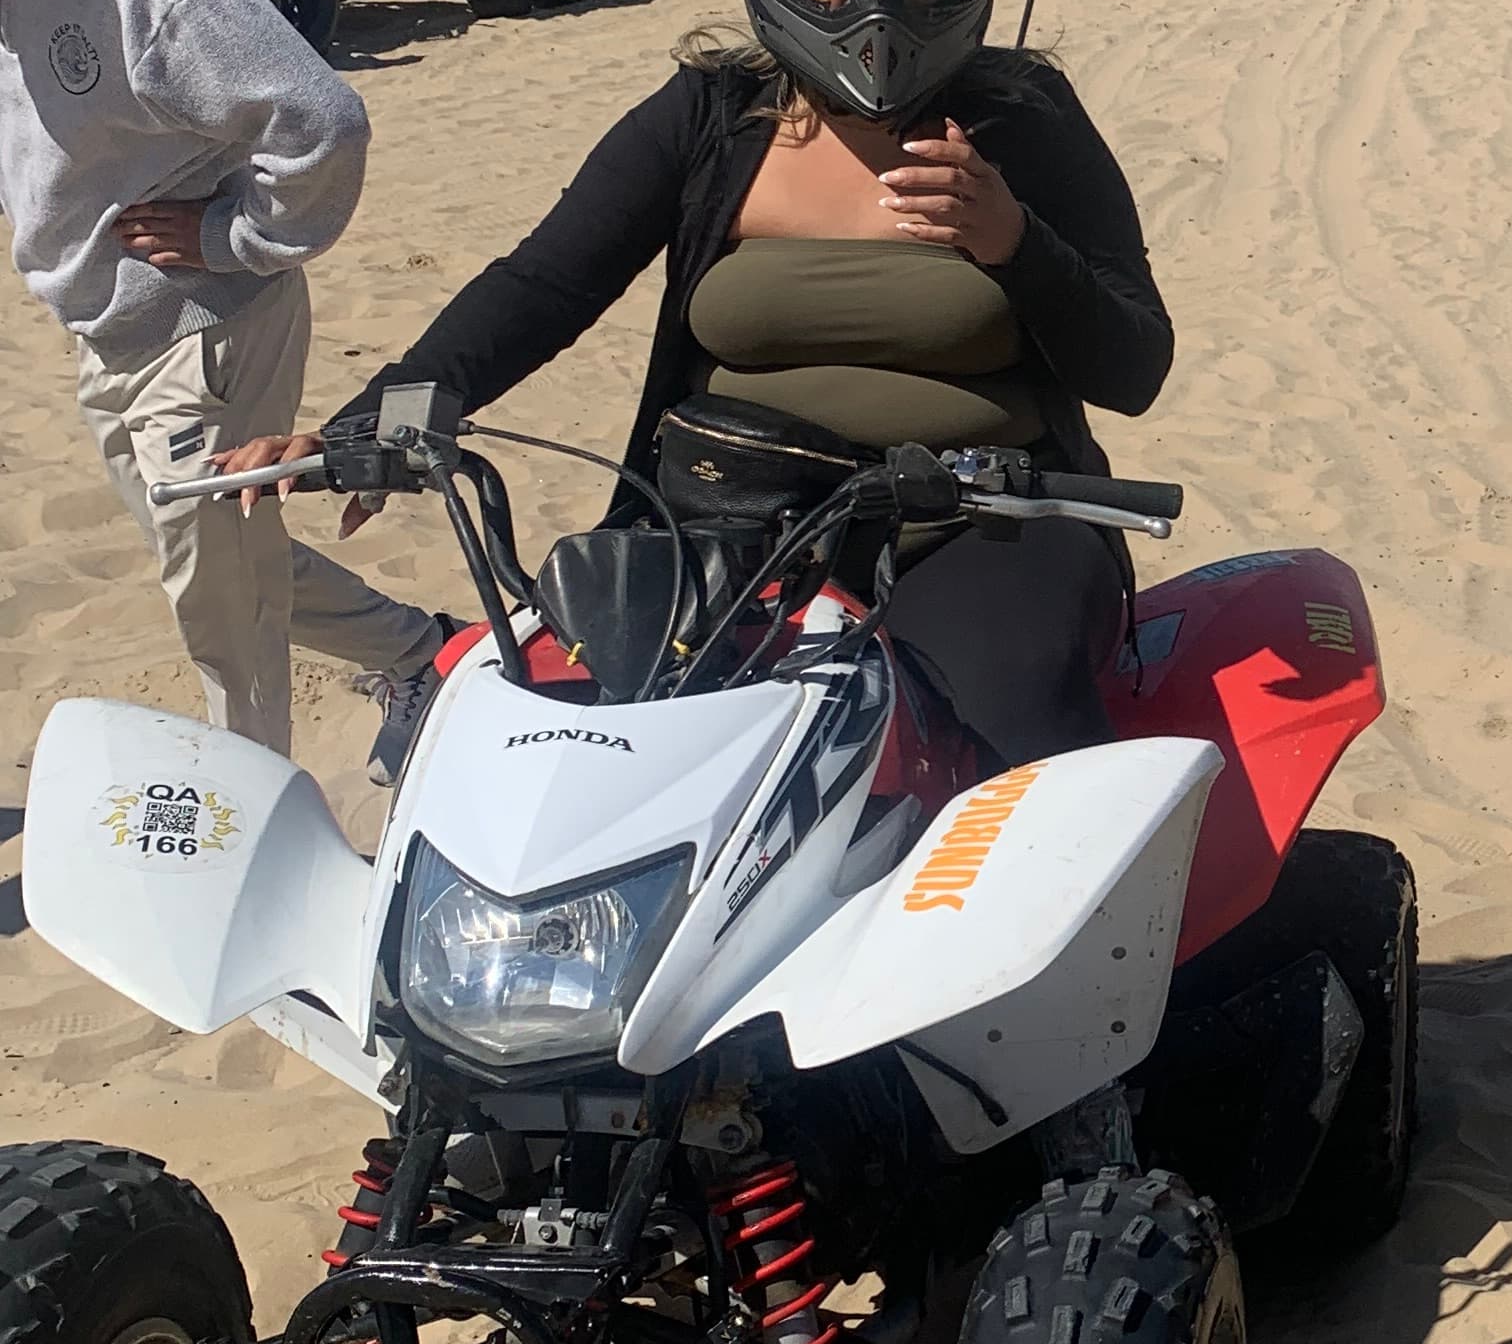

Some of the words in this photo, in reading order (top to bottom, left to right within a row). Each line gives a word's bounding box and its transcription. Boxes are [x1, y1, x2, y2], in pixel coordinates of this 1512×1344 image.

[51, 23, 71, 45] KEEP
[503, 729, 635, 753] HONDA
[146, 784, 202, 805] QA
[136, 834, 199, 856] 166
[726, 848, 772, 912] 250X
